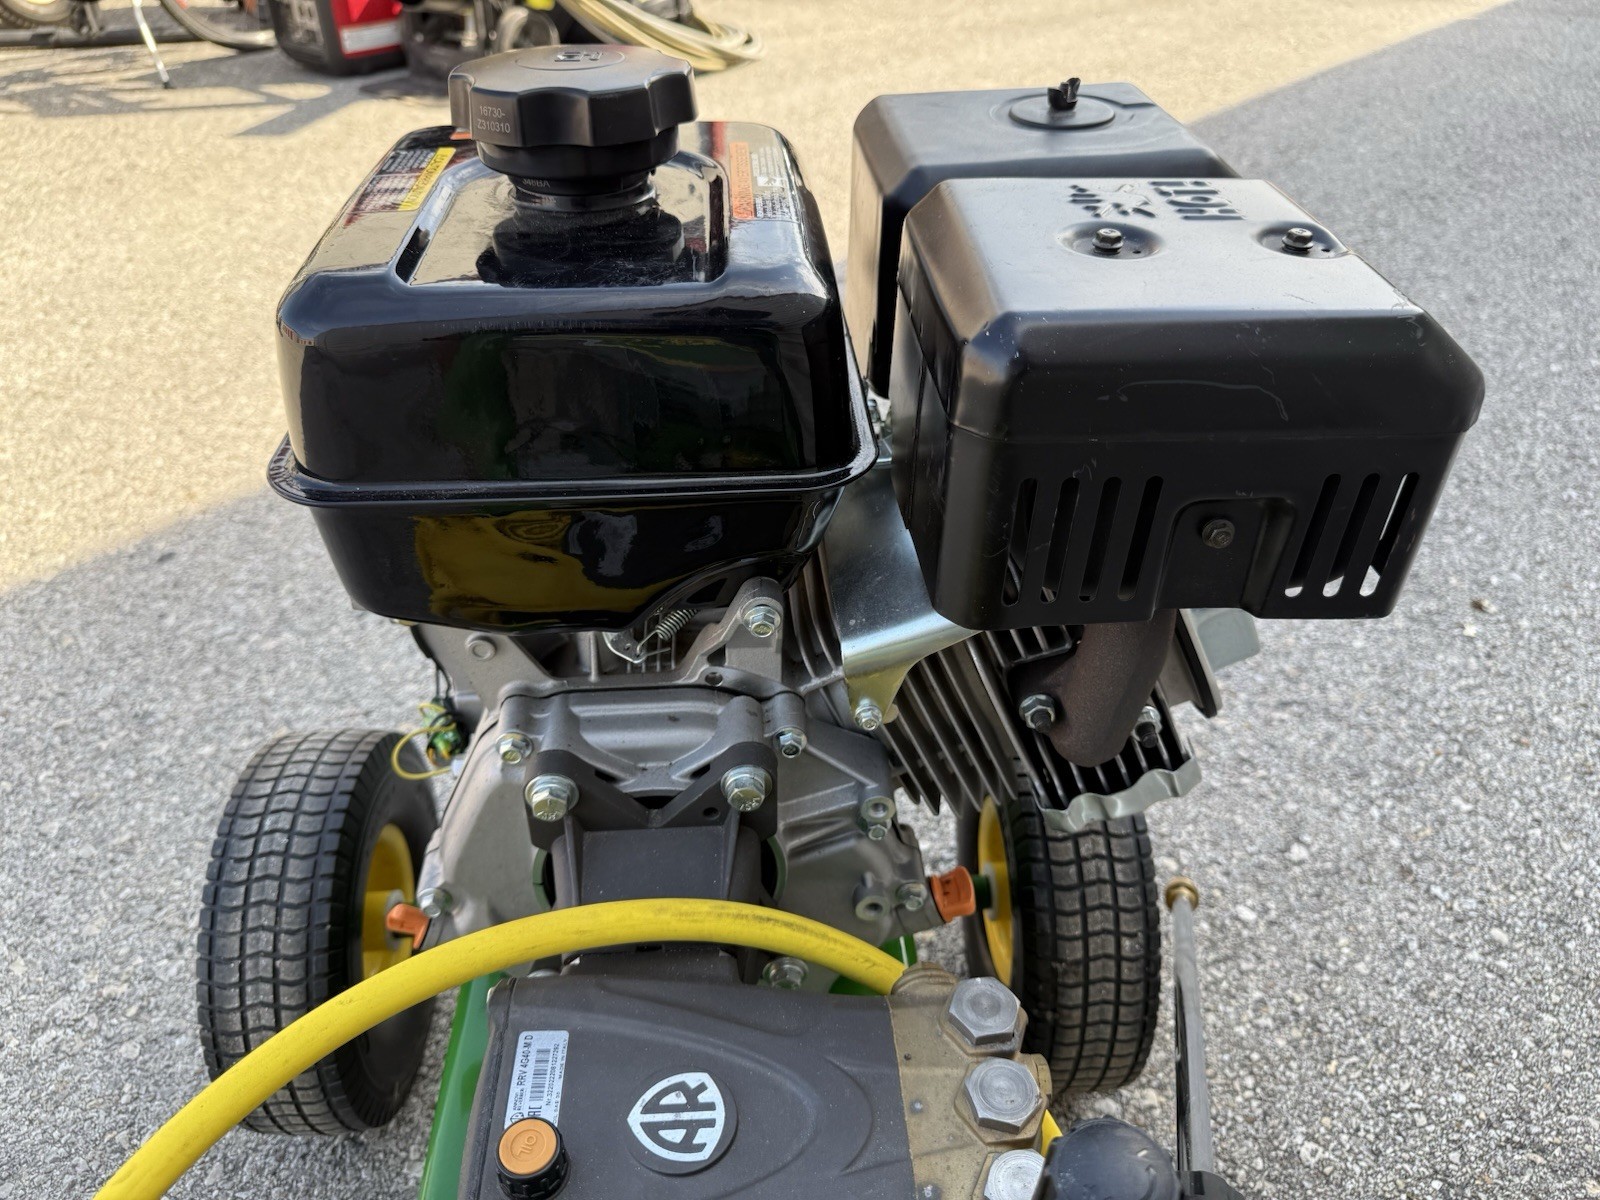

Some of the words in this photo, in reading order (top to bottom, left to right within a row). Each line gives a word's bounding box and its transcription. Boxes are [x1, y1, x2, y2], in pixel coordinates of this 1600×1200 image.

[479, 105, 505, 118] 16730-
[477, 119, 511, 133] Z310310
[517, 1069, 528, 1086] RRV
[515, 1134, 538, 1157] OIL
